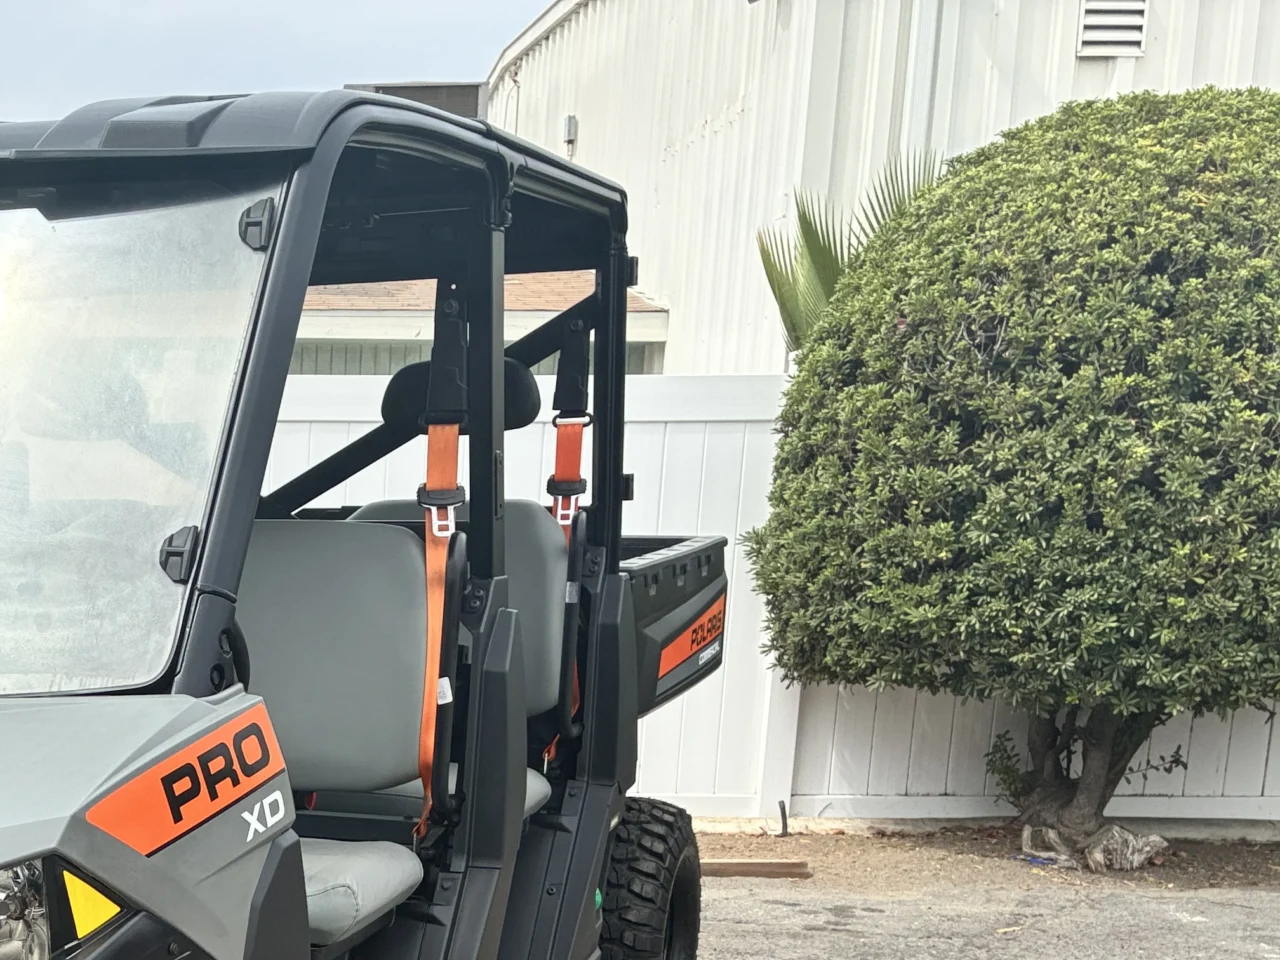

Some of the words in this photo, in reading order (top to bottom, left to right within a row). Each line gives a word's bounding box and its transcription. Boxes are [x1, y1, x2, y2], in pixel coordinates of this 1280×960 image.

[690, 610, 723, 651] POLARIS
[161, 722, 271, 825] PRO
[241, 790, 286, 843] XD
